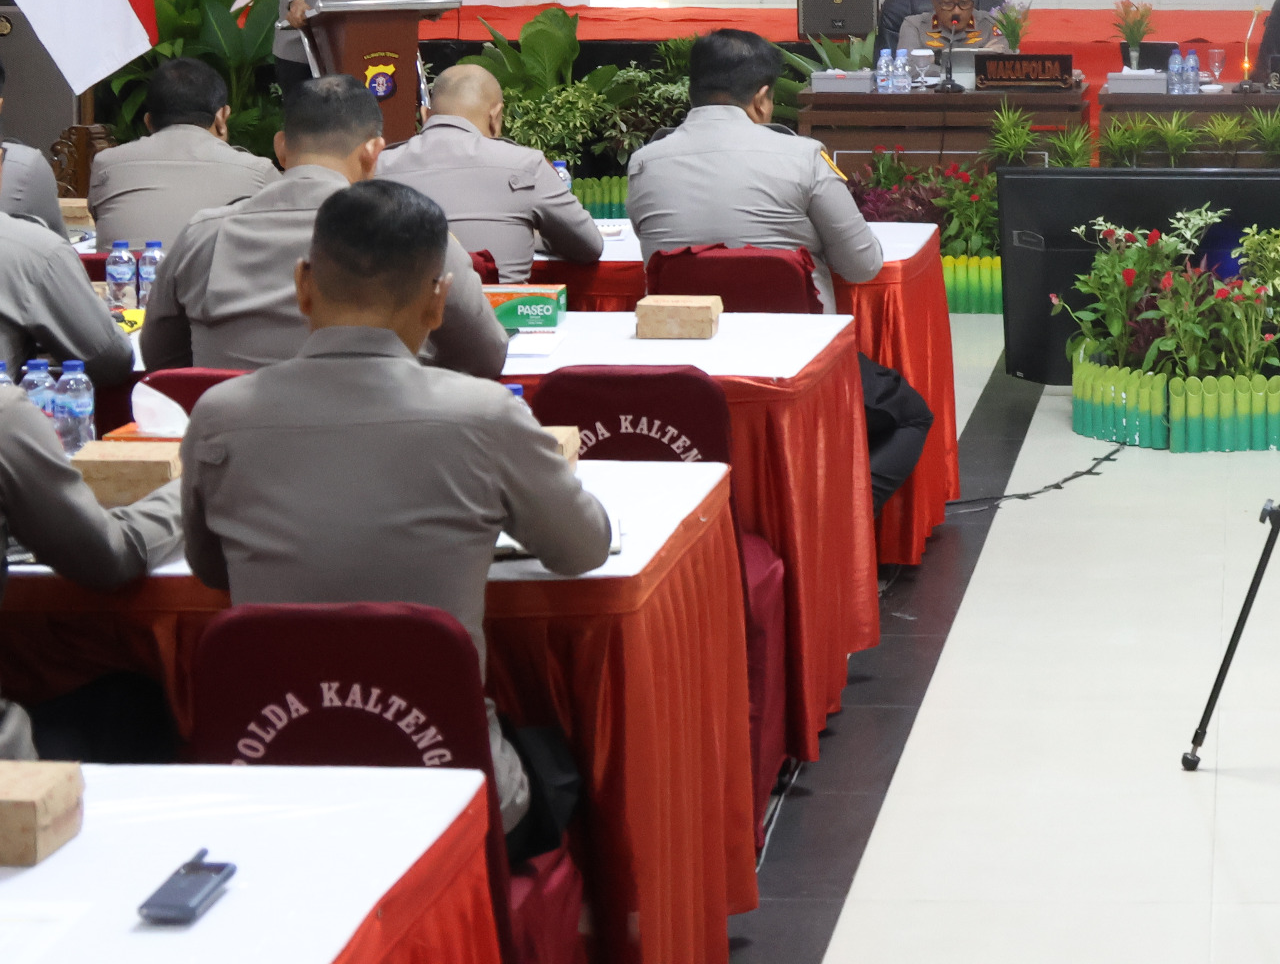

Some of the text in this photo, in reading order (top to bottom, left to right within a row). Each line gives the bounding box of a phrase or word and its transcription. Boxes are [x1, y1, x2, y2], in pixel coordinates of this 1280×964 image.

[985, 60, 1061, 79] WAKAPOLDA
[517, 304, 553, 316] PASEO
[619, 414, 702, 462] KALTEN
[320, 681, 453, 767] KALTENG
